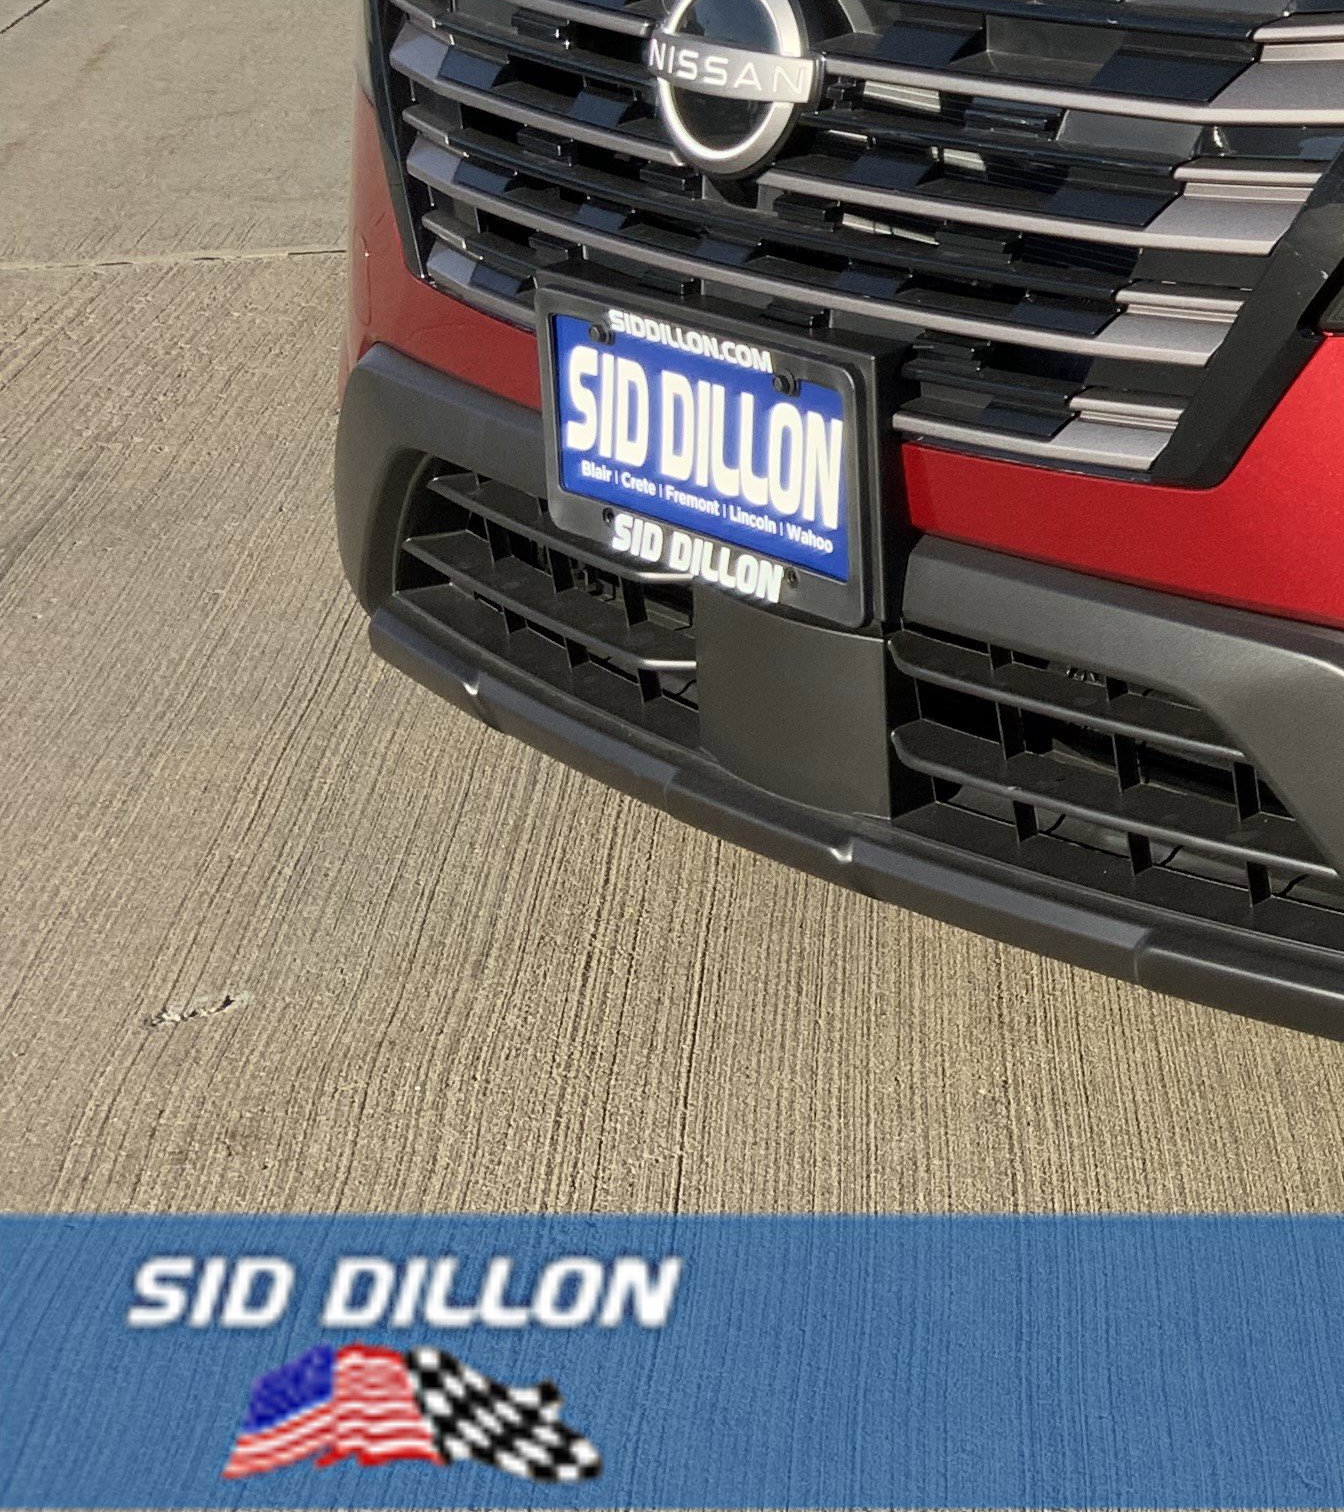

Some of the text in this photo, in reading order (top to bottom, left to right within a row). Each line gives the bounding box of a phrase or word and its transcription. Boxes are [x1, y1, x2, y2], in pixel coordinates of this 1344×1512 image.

[649, 38, 806, 95] NISSAN
[608, 309, 774, 374] SIDDILLON.COM
[566, 345, 844, 531] SID DILLON
[581, 459, 834, 554] Blair Crete Fremont Lincoln Wahoo
[611, 513, 784, 604] SID DILLON
